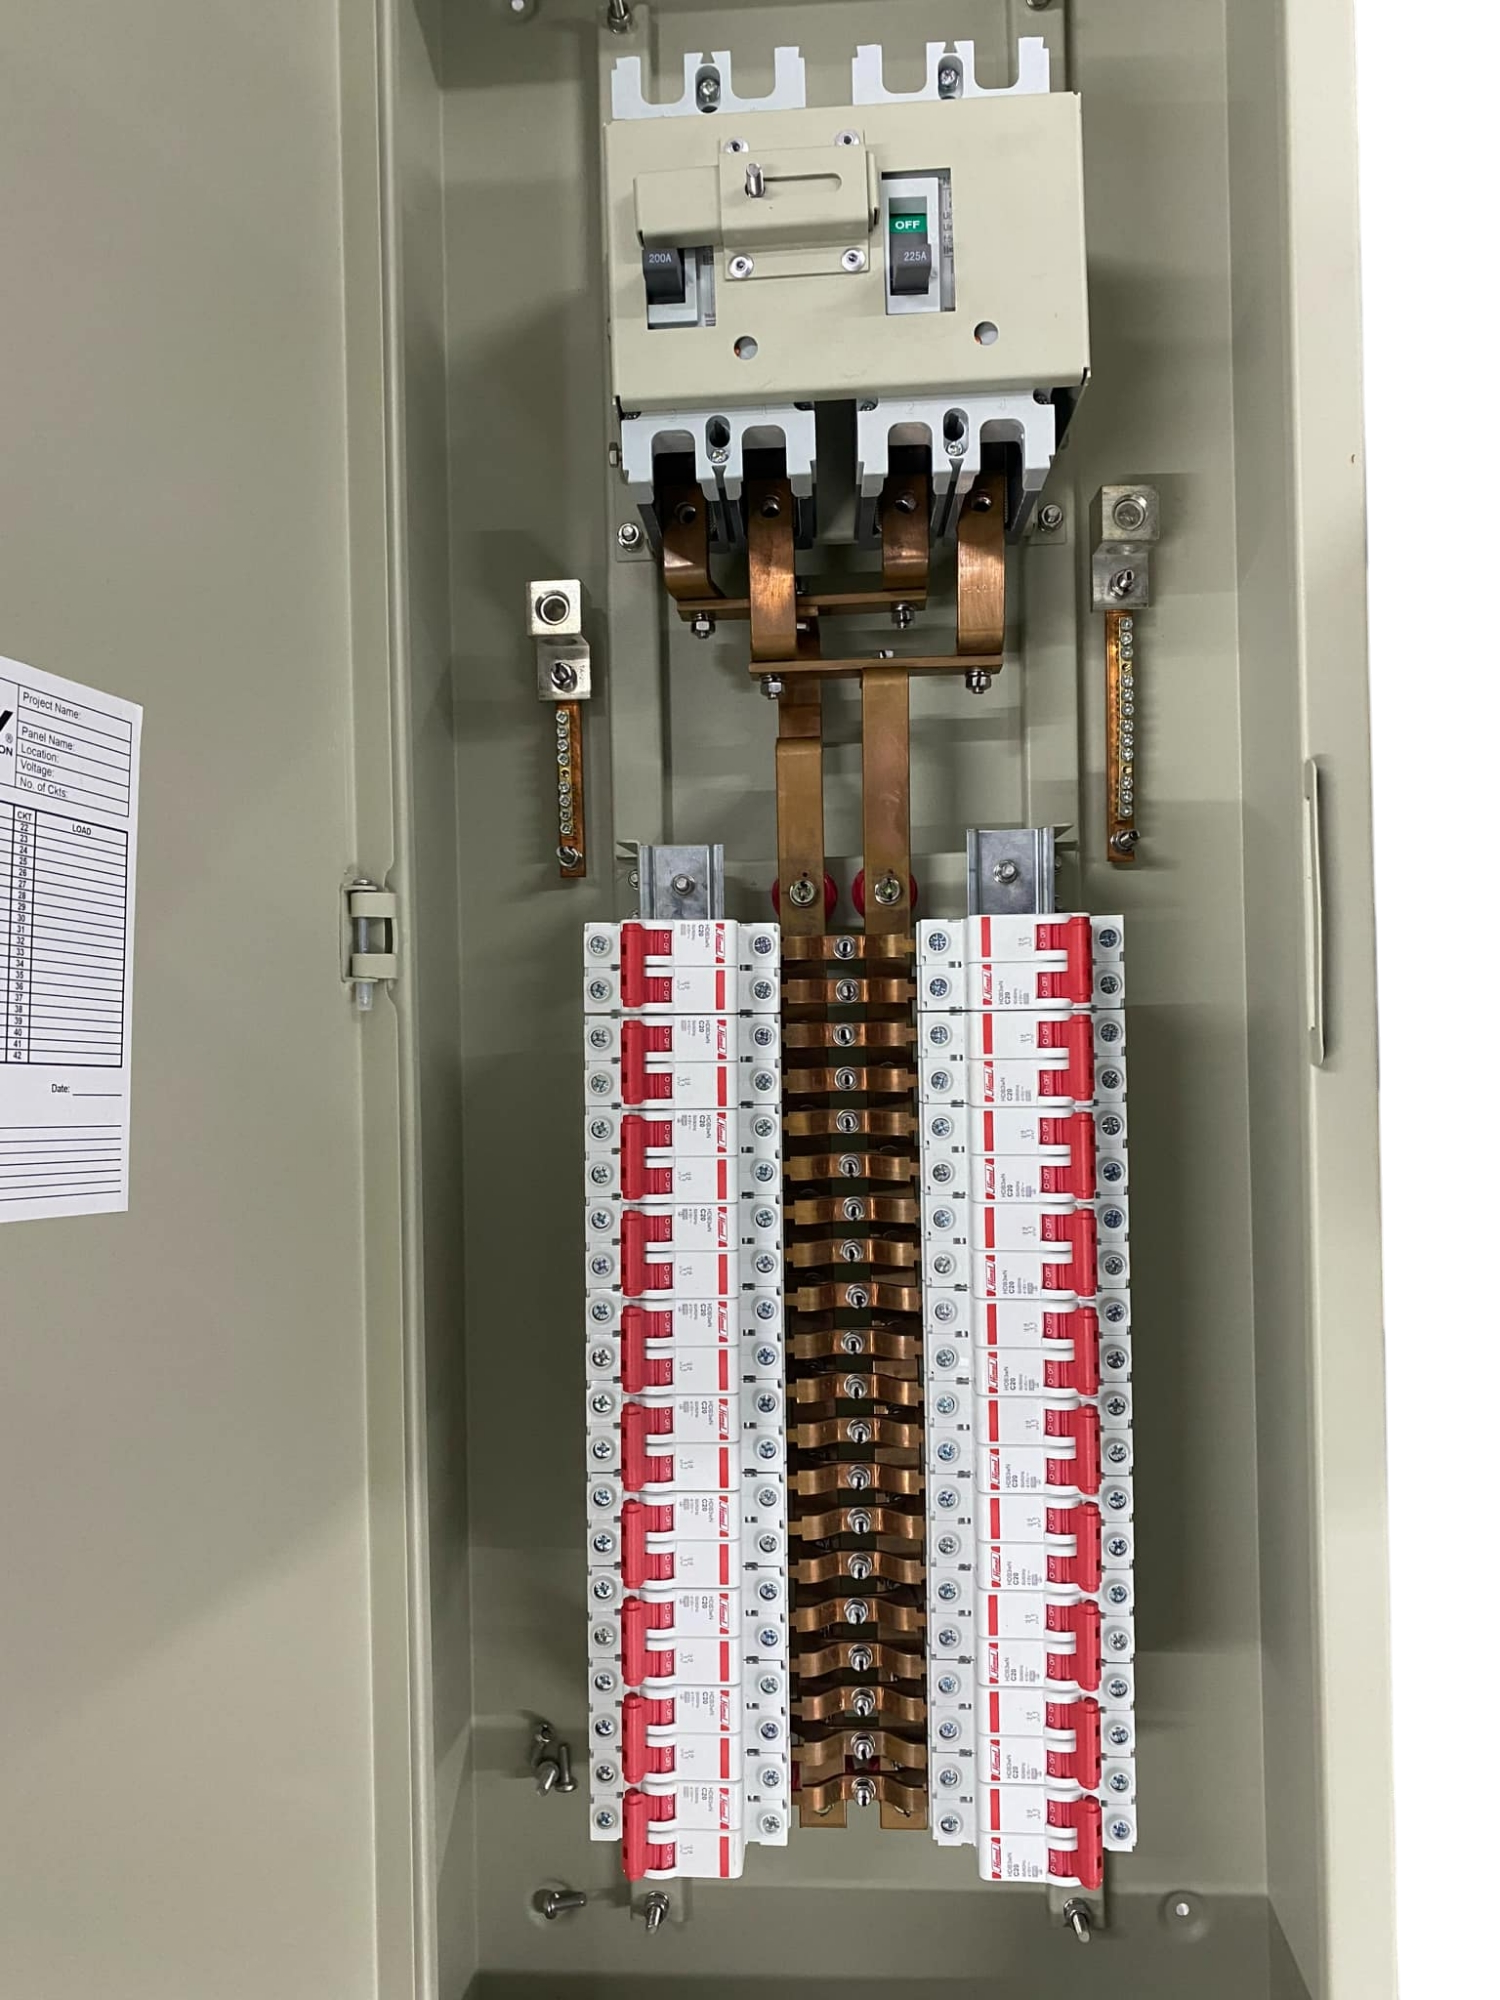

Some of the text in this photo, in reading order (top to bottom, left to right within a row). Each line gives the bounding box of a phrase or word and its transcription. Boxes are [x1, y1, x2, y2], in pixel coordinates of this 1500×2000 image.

[895, 220, 920, 230] OFF
[648, 253, 672, 264] 200A
[903, 251, 927, 262] 225A
[23, 691, 82, 720] Project Name:
[21, 726, 76, 751] Panel Name:
[20, 743, 60, 763] Location:
[20, 759, 55, 778] Voltage:
[19, 776, 69, 799] No. of Ckts:
[17, 811, 32, 821] CKT
[20, 823, 29, 832] 22
[72, 824, 92, 836] LOAD
[51, 1083, 70, 1093] Date:
